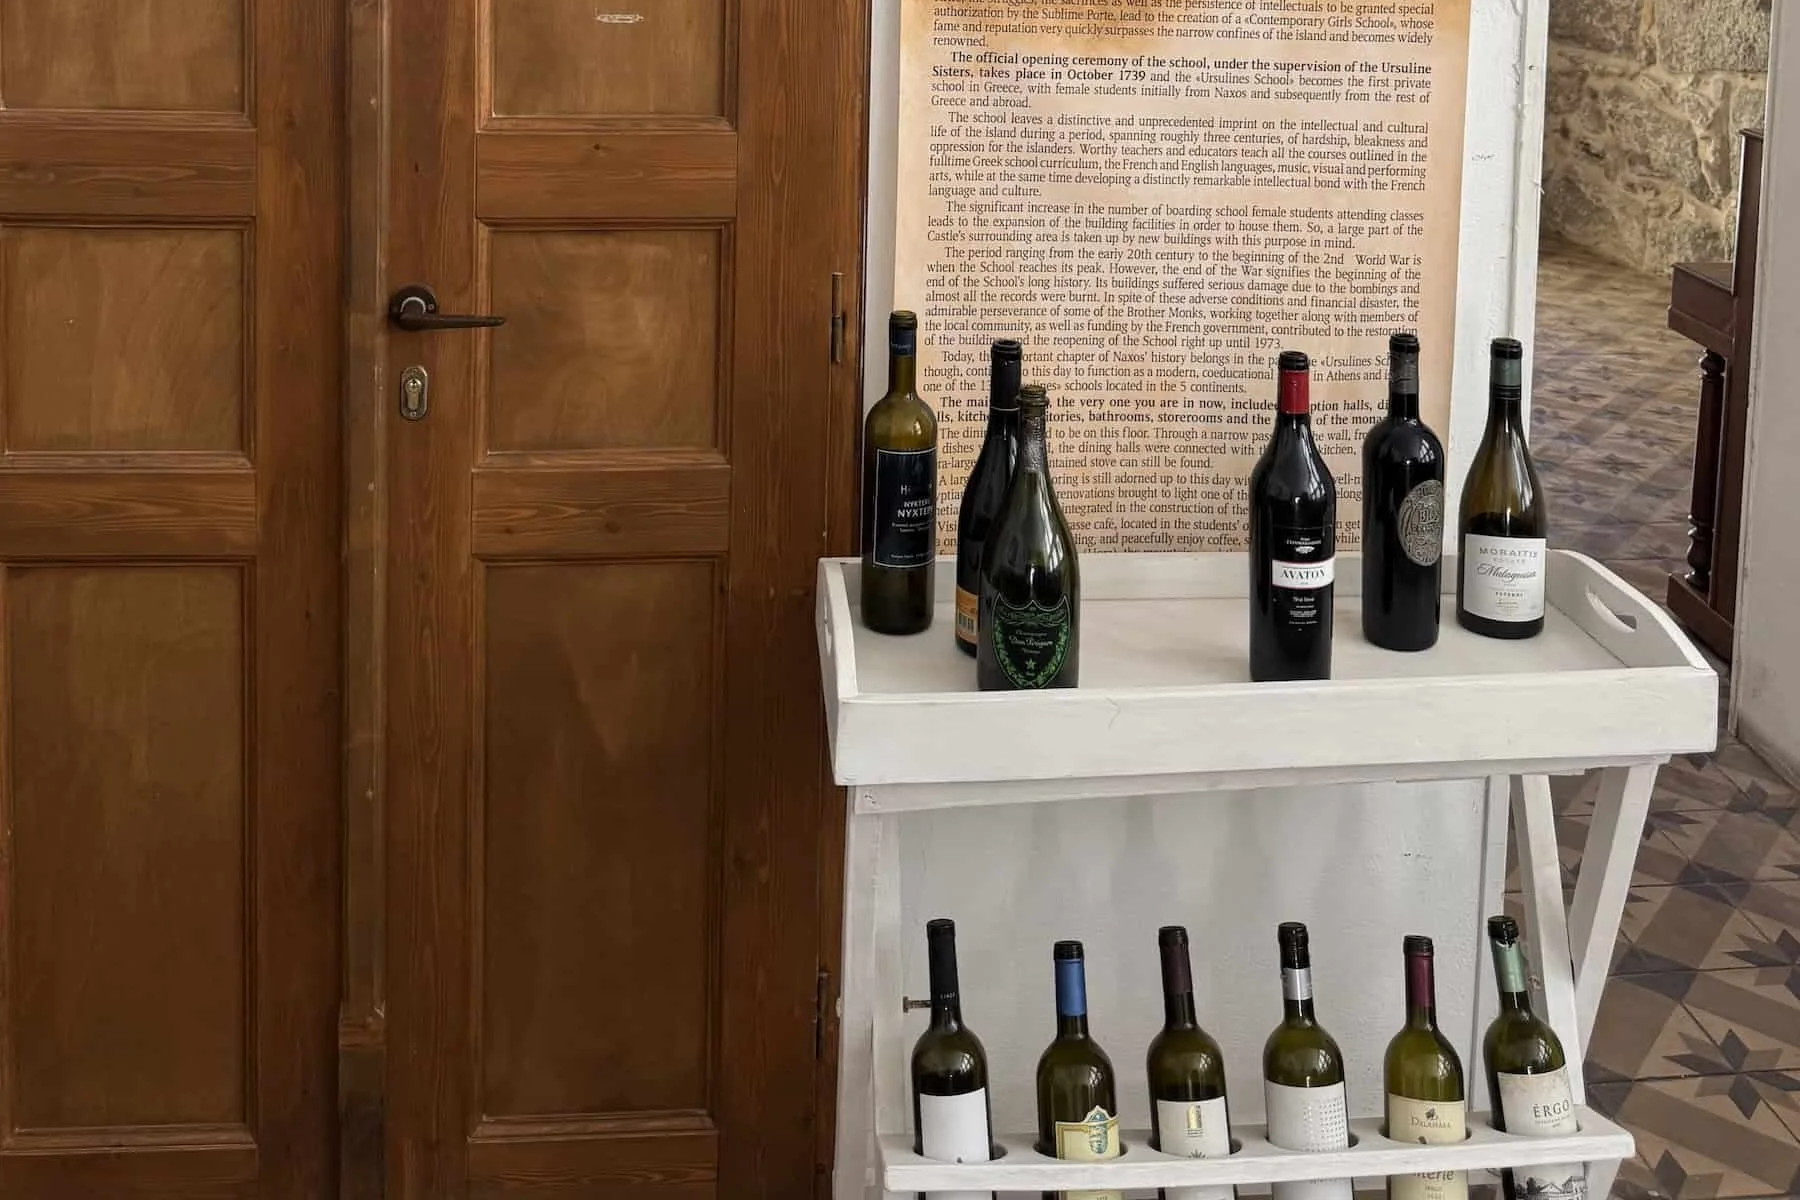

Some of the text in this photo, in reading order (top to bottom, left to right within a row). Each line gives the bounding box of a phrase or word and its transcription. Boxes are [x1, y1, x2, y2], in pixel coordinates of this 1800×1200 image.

[950, 51, 1431, 74] The official opening ceremony of the school, under the supervision of the Ursuline
[932, 64, 974, 78] Sisters,
[979, 65, 1010, 78] takes
[1015, 66, 1046, 82] place
[1050, 67, 1062, 79] in
[1066, 68, 1113, 80] October
[1119, 69, 1146, 81] 1739
[1150, 70, 1170, 82] and
[1174, 70, 1191, 82] the
[1298, 73, 1343, 86] becomes
[1347, 75, 1364, 87] the
[1368, 75, 1389, 87] first
[1394, 76, 1431, 91] private
[931, 79, 1430, 103] school in Greece, with female students initially from Naxos and subsequently from the rest of
[948, 110, 1428, 133] The school leaves a distinctive and unprecedented imprint on the intellectual and cultural
[930, 125, 1428, 148] life of the island during a period, spanning roughly three centuries, of hardship, bleakness and
[925, 304, 1418, 325] admirable perseverance of some of the Brother Monks, working together along with members of
[1064, 378, 1246, 392] schools located in the 5 continents.
[1056, 395, 1226, 410] the very one you are in now,
